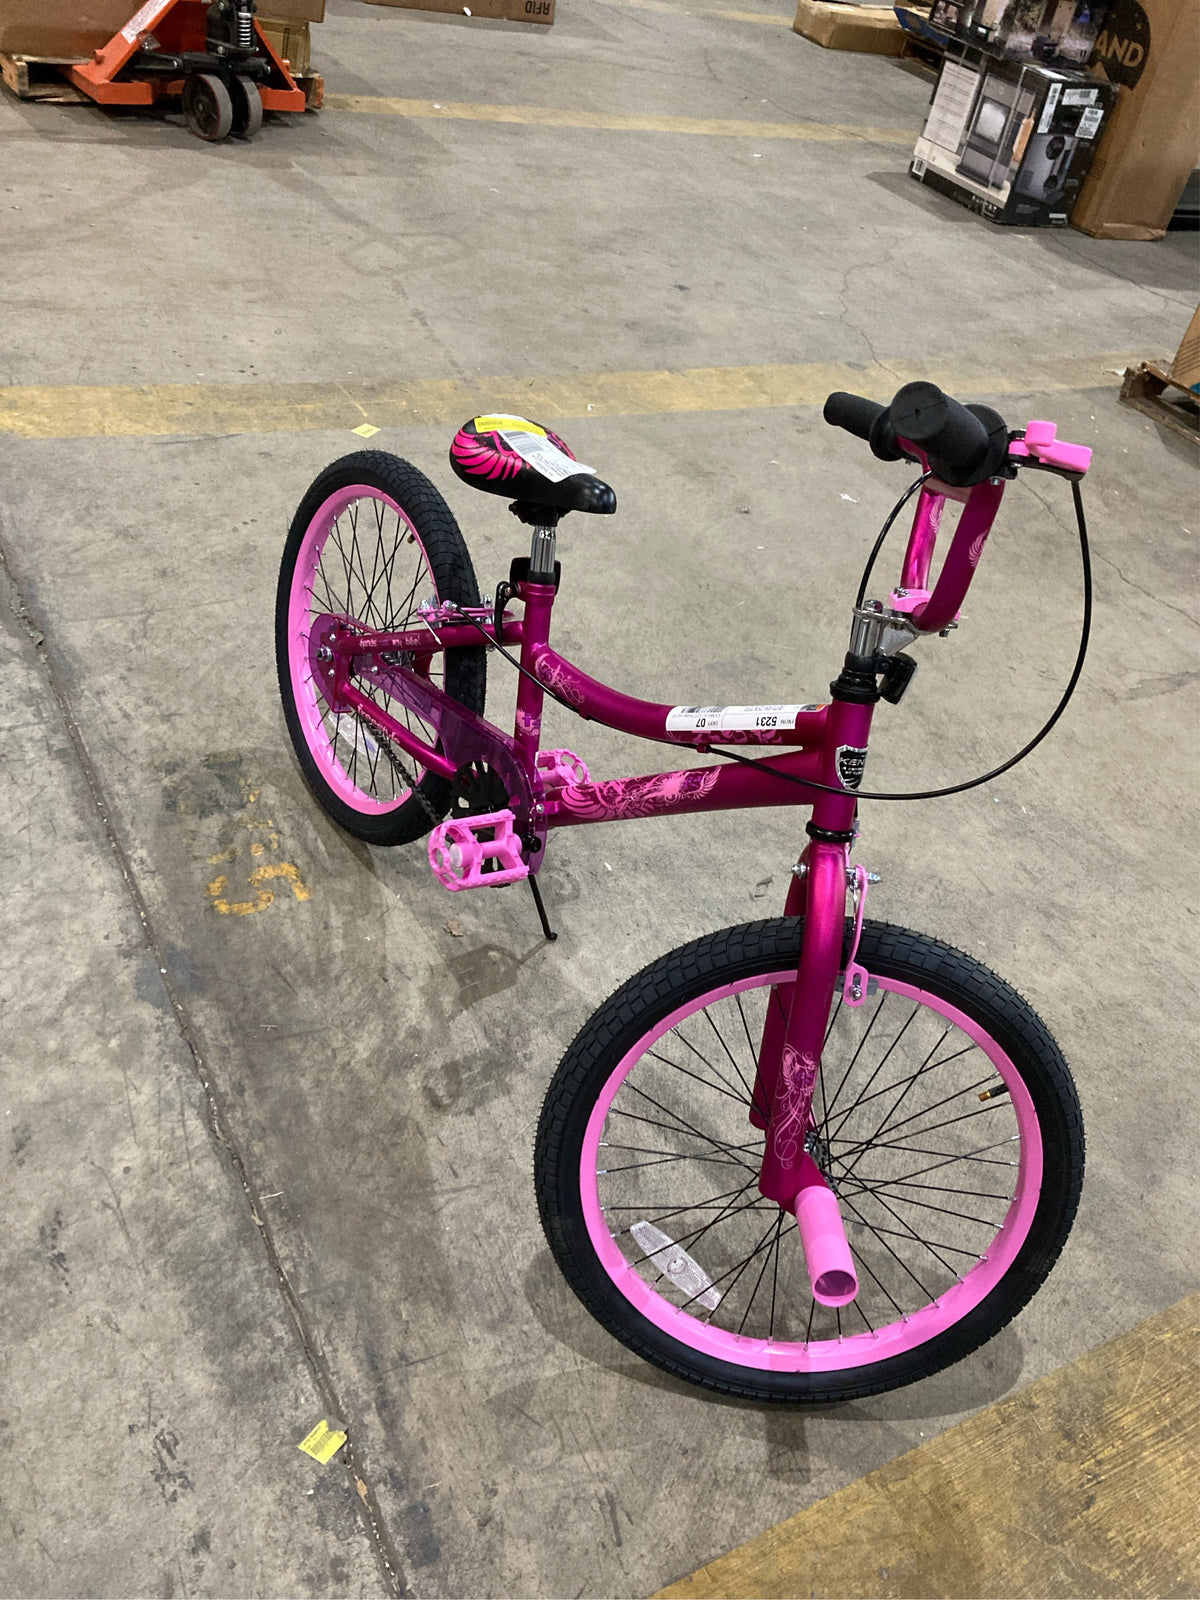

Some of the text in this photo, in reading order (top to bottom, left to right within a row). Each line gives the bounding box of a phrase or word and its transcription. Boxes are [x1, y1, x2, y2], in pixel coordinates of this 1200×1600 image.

[525, 1, 550, 15] RFID
[696, 718, 706, 728] 07
[755, 716, 778, 727] 5231
